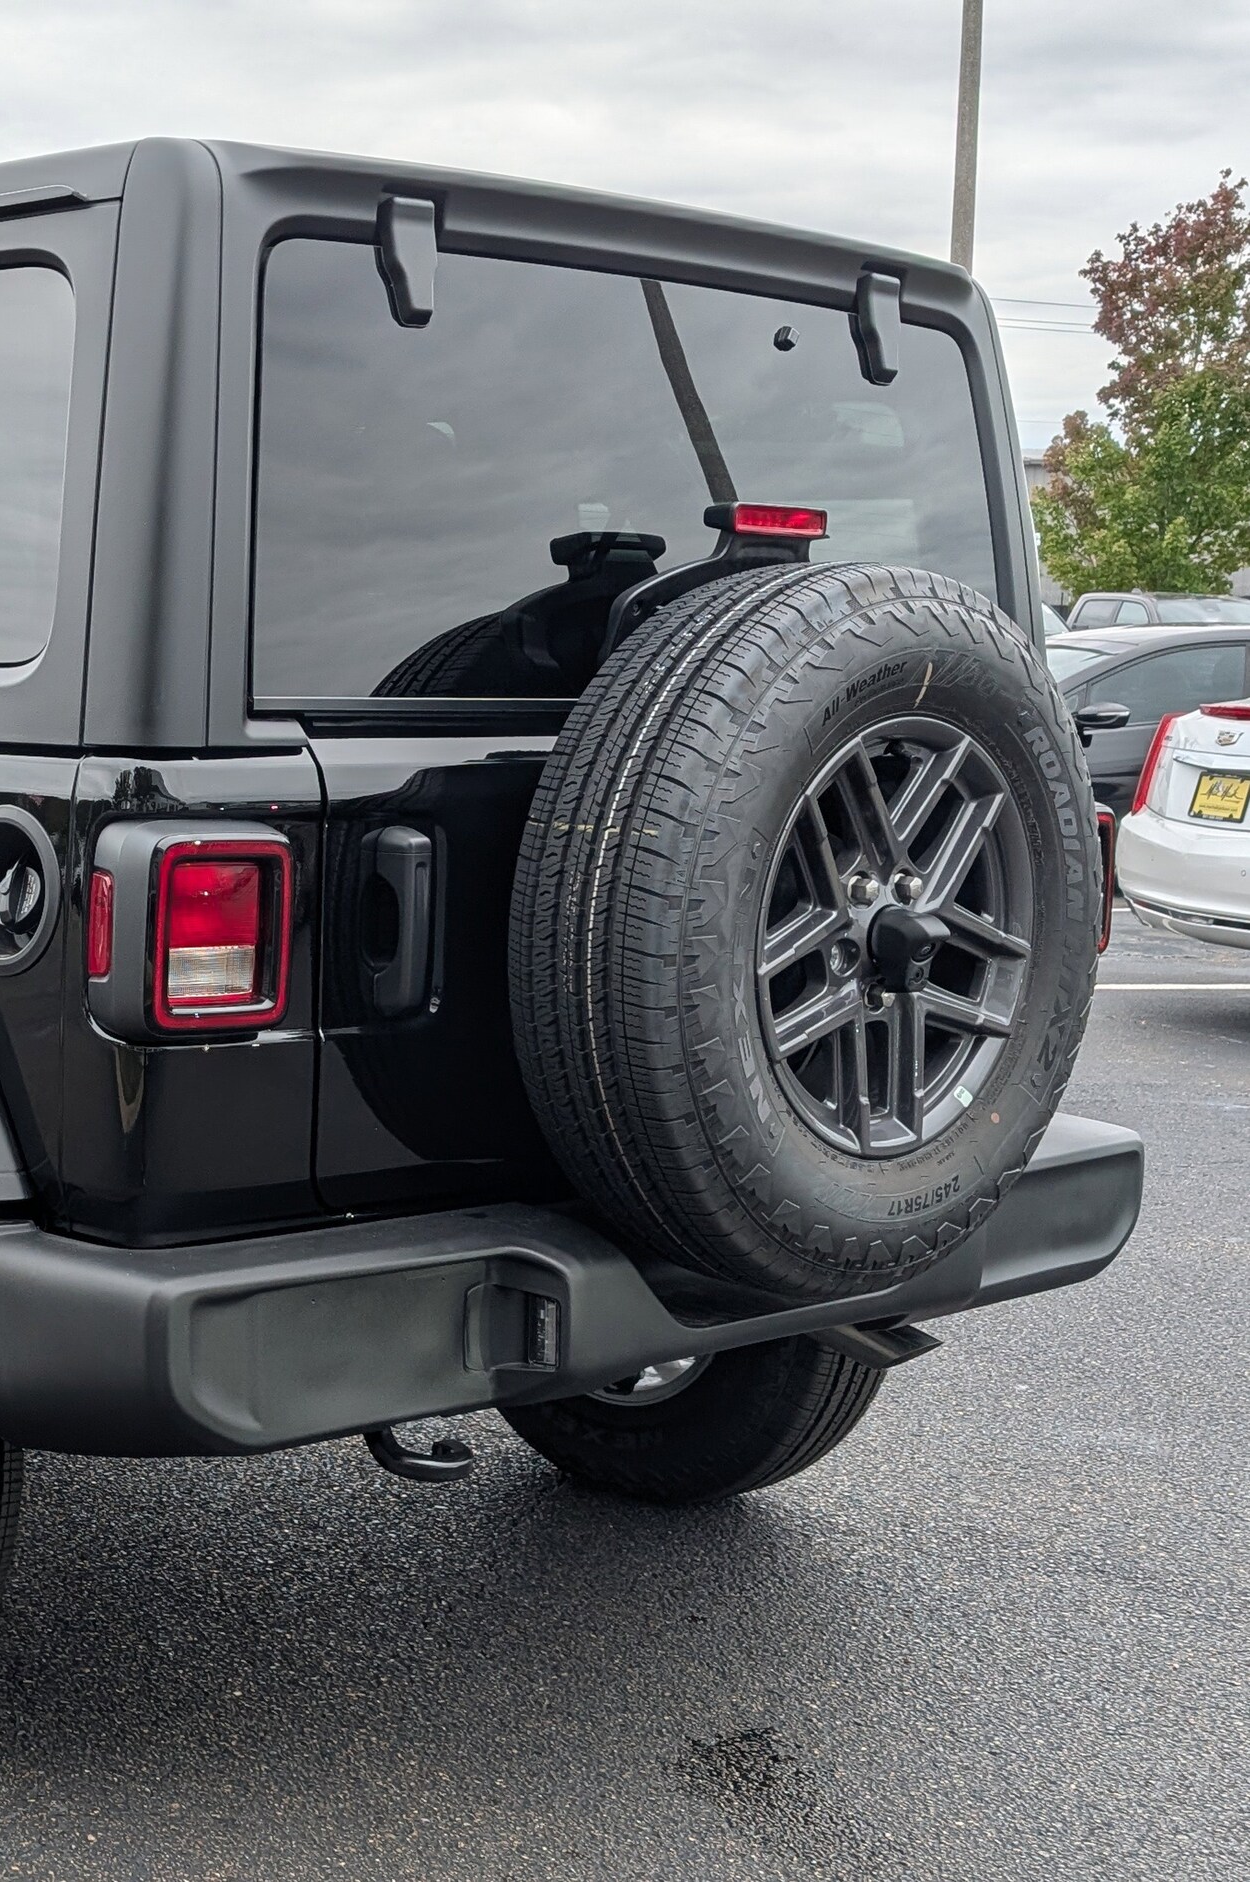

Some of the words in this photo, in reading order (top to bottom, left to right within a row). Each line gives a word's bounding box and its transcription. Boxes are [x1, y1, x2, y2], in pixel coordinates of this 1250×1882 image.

[821, 661, 908, 727] All-Weather
[1023, 726, 1085, 923] ROADIAN
[887, 1174, 961, 1217] 245/75R17
